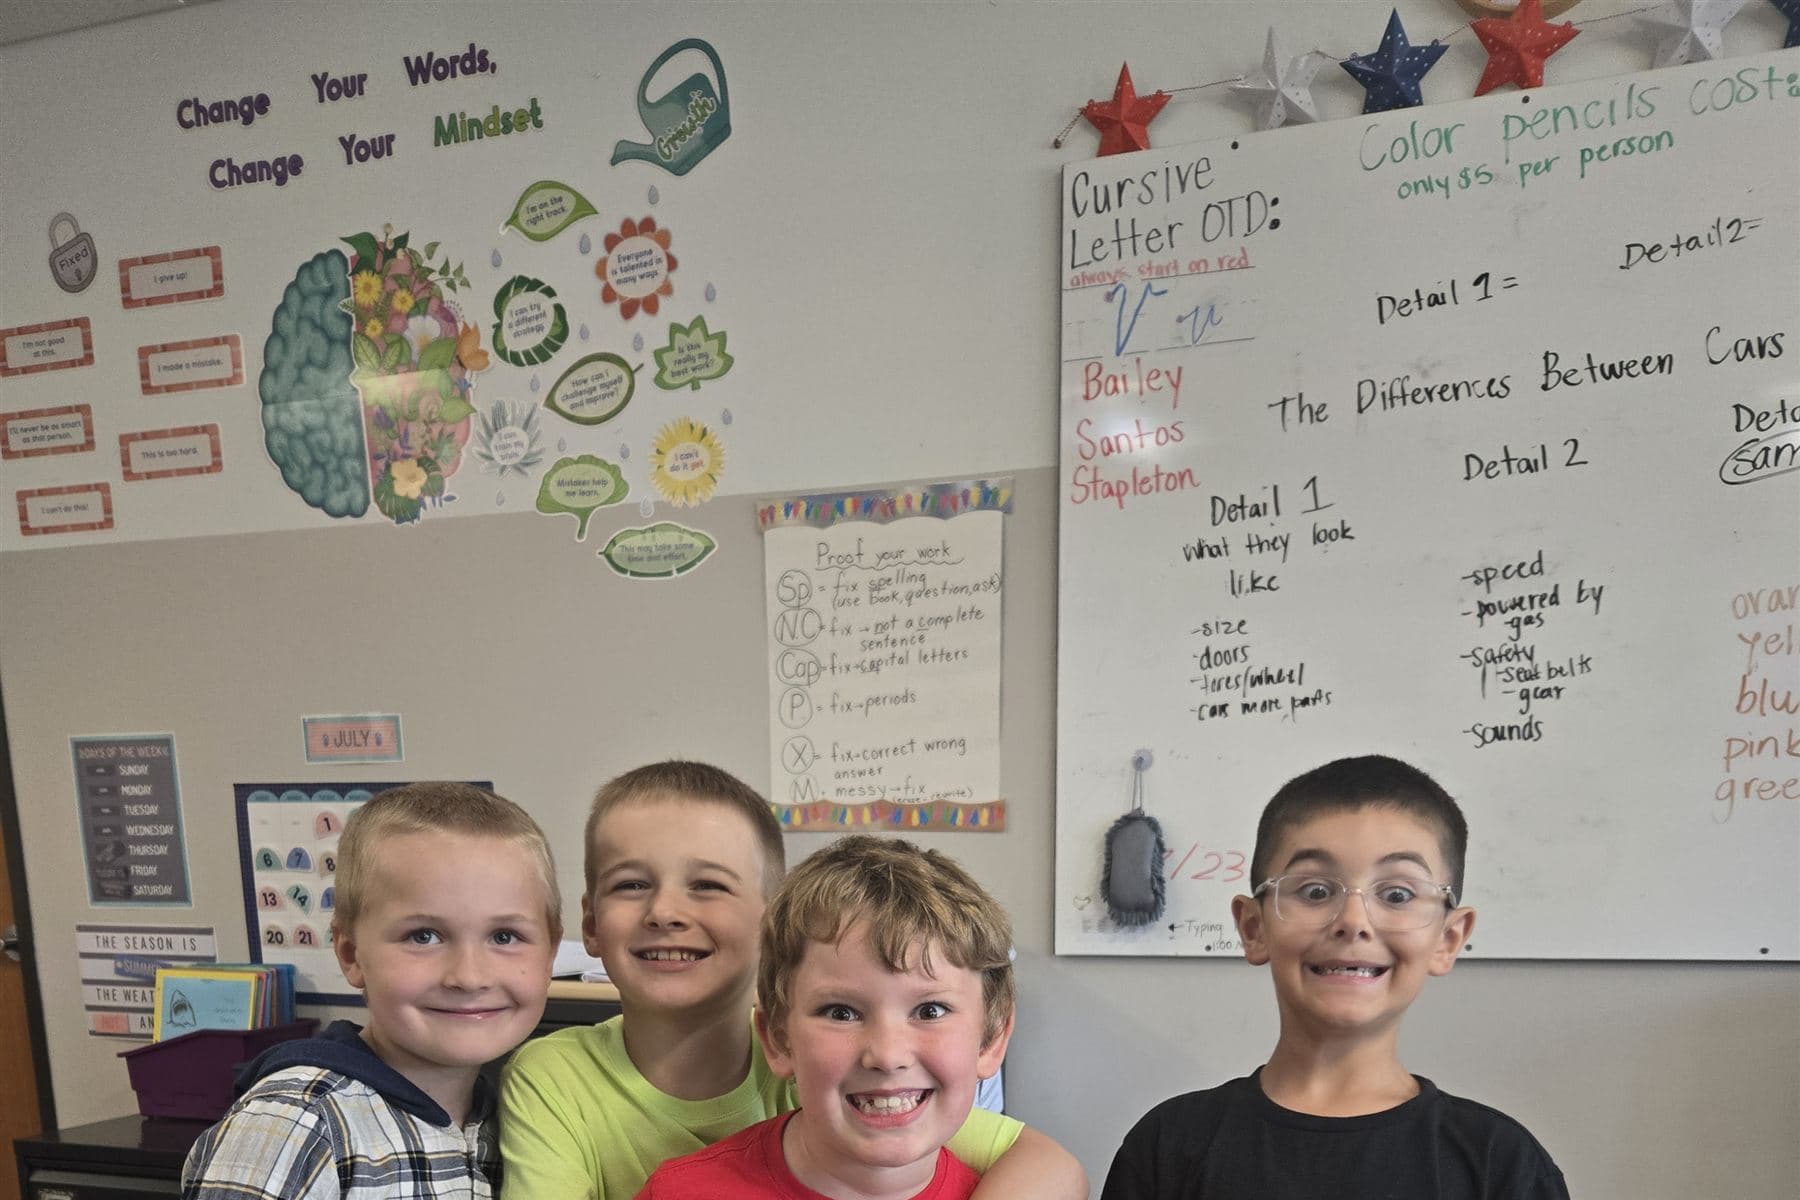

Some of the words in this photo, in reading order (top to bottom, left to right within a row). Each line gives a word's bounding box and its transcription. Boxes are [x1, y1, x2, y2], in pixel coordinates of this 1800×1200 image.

[177, 93, 271, 129] Change
[311, 72, 367, 103] Your
[403, 43, 497, 86] Words,
[656, 90, 716, 161] Growth
[1358, 118, 1466, 174] Color
[1502, 82, 1662, 165] pencils
[209, 154, 304, 189] Change
[339, 134, 395, 164] Your
[434, 98, 543, 146] Mindset
[1397, 173, 1450, 201] only
[1458, 161, 1496, 191] $5
[1519, 154, 1561, 189] per
[1579, 127, 1675, 180] person
[1071, 157, 1215, 219] Cursive
[539, 201, 549, 210] on
[550, 195, 564, 206] the
[525, 213, 545, 226] right
[1070, 217, 1185, 272] Letter
[59, 247, 90, 272] Fixed
[620, 260, 650, 274] talented
[1070, 265, 1130, 288] always
[1137, 259, 1180, 277] start
[1187, 257, 1210, 273] on
[1216, 246, 1250, 269] red
[158, 273, 174, 283] give
[616, 276, 637, 287] many
[1376, 276, 1459, 325] Detail
[162, 362, 185, 373] made
[1267, 391, 1330, 433] The
[1356, 373, 1512, 416] Differences
[1540, 350, 1675, 392] Between
[1705, 325, 1786, 366] Cars
[1081, 356, 1184, 410] Bailey
[1075, 416, 1185, 462] Santos
[1463, 443, 1549, 482] Detail
[1563, 437, 1590, 468] 2
[1070, 462, 1201, 511] Stapleton
[1210, 484, 1281, 527] Detail
[1301, 474, 1336, 515] 1
[816, 537, 866, 567] Proof
[874, 548, 906, 564] your
[917, 540, 952, 558] work
[1182, 535, 1231, 563] what
[1245, 531, 1292, 564] they
[1312, 519, 1357, 546] look
[832, 571, 859, 593] fix
[868, 567, 927, 593] spelling
[1230, 569, 1281, 598] like
[1576, 578, 1605, 616] by
[828, 616, 853, 637] fix
[873, 614, 900, 635] not
[905, 619, 914, 629] a
[917, 605, 985, 632] complete
[860, 633, 927, 653] sentence
[780, 651, 820, 689] Cap
[829, 651, 852, 676] fix
[859, 651, 910, 675] capital
[918, 648, 969, 665] letters
[1546, 653, 1593, 681] belts
[789, 693, 806, 721] P
[829, 692, 854, 715] fix
[865, 691, 917, 718] periods
[1240, 697, 1284, 716] more
[1288, 688, 1333, 724] parts
[333, 730, 371, 748] JULY
[831, 742, 855, 763] fix
[861, 740, 917, 762] correct
[924, 736, 967, 757] wrong
[119, 764, 149, 776] SUNDAY
[834, 766, 884, 781] answer
[121, 785, 152, 796] MONDAY
[835, 782, 887, 800] messy
[904, 776, 927, 796] fix
[124, 804, 159, 816] TUESDAY
[126, 823, 174, 836] WEDNESDAY
[323, 817, 331, 831] 1
[128, 844, 168, 856] THURSDAY
[263, 853, 273, 867] 6
[295, 852, 304, 866] 7
[326, 857, 336, 872] 8
[130, 864, 157, 876] FRIDAY
[133, 885, 173, 896] SATURDAY
[262, 892, 278, 906] 13
[292, 887, 308, 908] 14
[95, 935, 117, 948] THE
[124, 936, 173, 950] SEASON
[182, 938, 198, 951] IS
[267, 930, 284, 945] 20
[299, 930, 313, 946] 21
[1184, 919, 1223, 942] Typing
[96, 987, 118, 1001] THE
